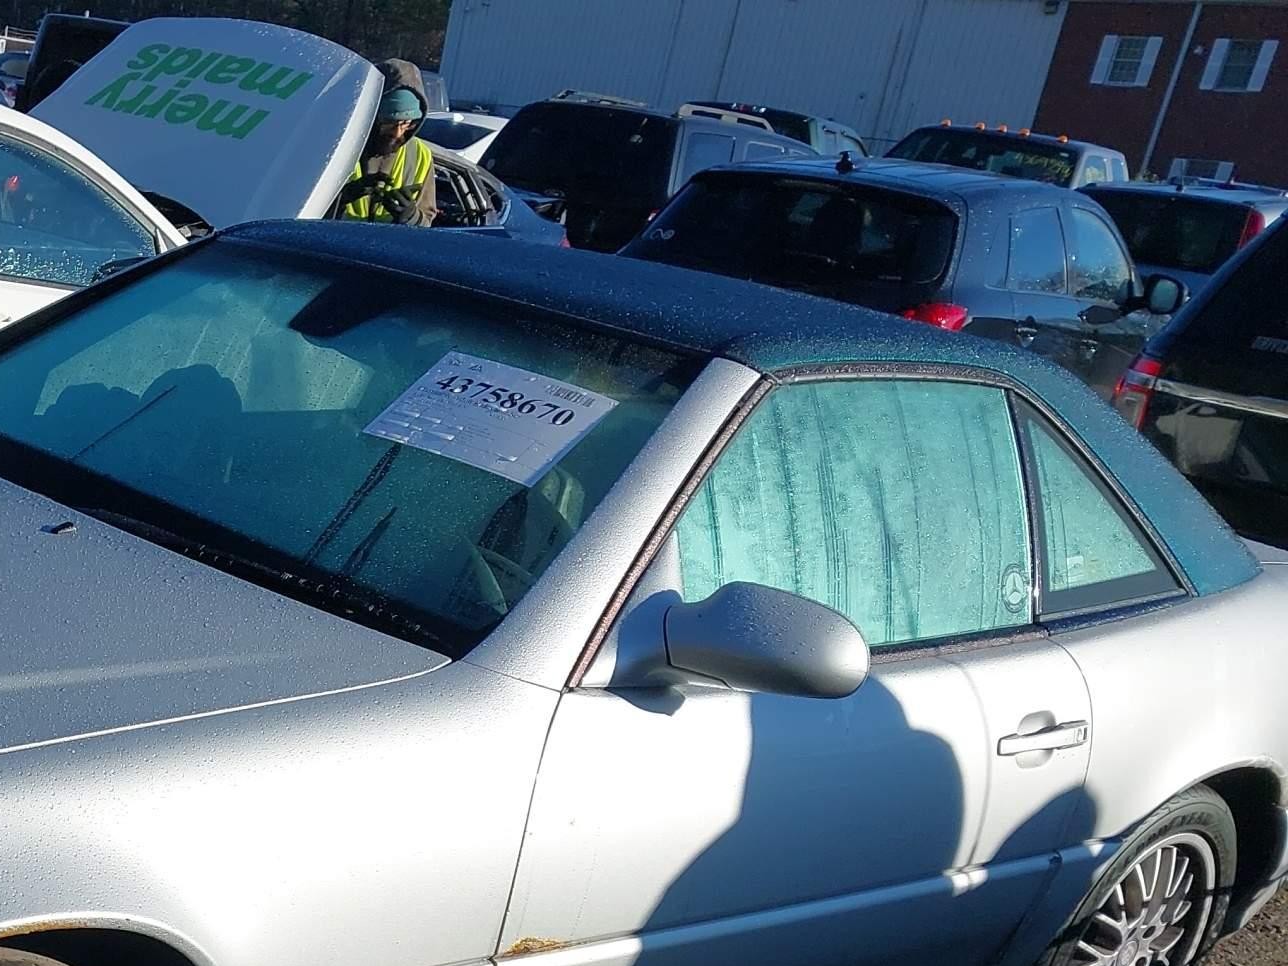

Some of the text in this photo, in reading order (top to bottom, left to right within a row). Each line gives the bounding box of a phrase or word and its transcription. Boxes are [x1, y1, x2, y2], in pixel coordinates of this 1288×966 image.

[127, 43, 315, 99] maids
[83, 72, 270, 139] merry
[435, 375, 576, 426] 43758670
